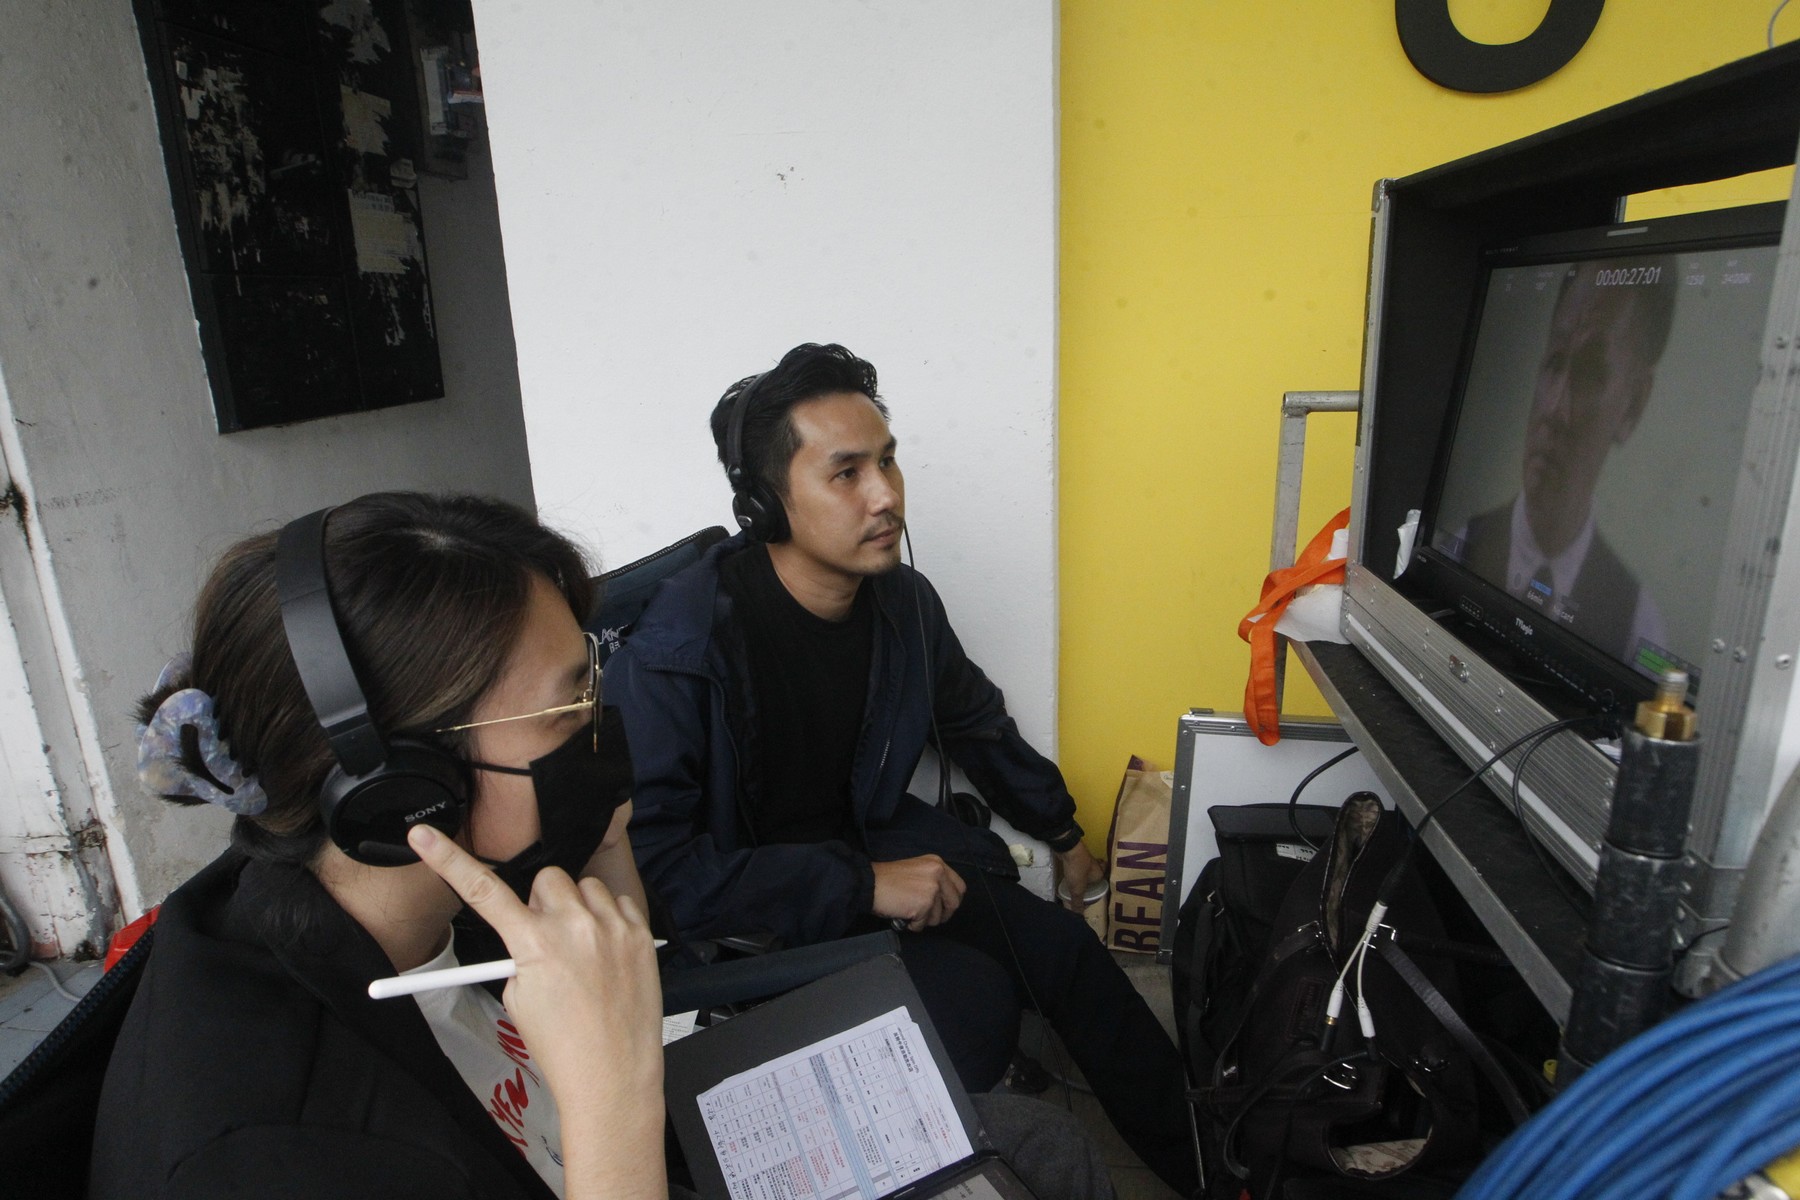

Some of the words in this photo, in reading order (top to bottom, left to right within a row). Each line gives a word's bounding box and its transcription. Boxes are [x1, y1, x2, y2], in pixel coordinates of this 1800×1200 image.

[1595, 266, 1662, 286] 00:00:27:01
[404, 801, 447, 823] SONY
[1113, 841, 1169, 951] BEAN
